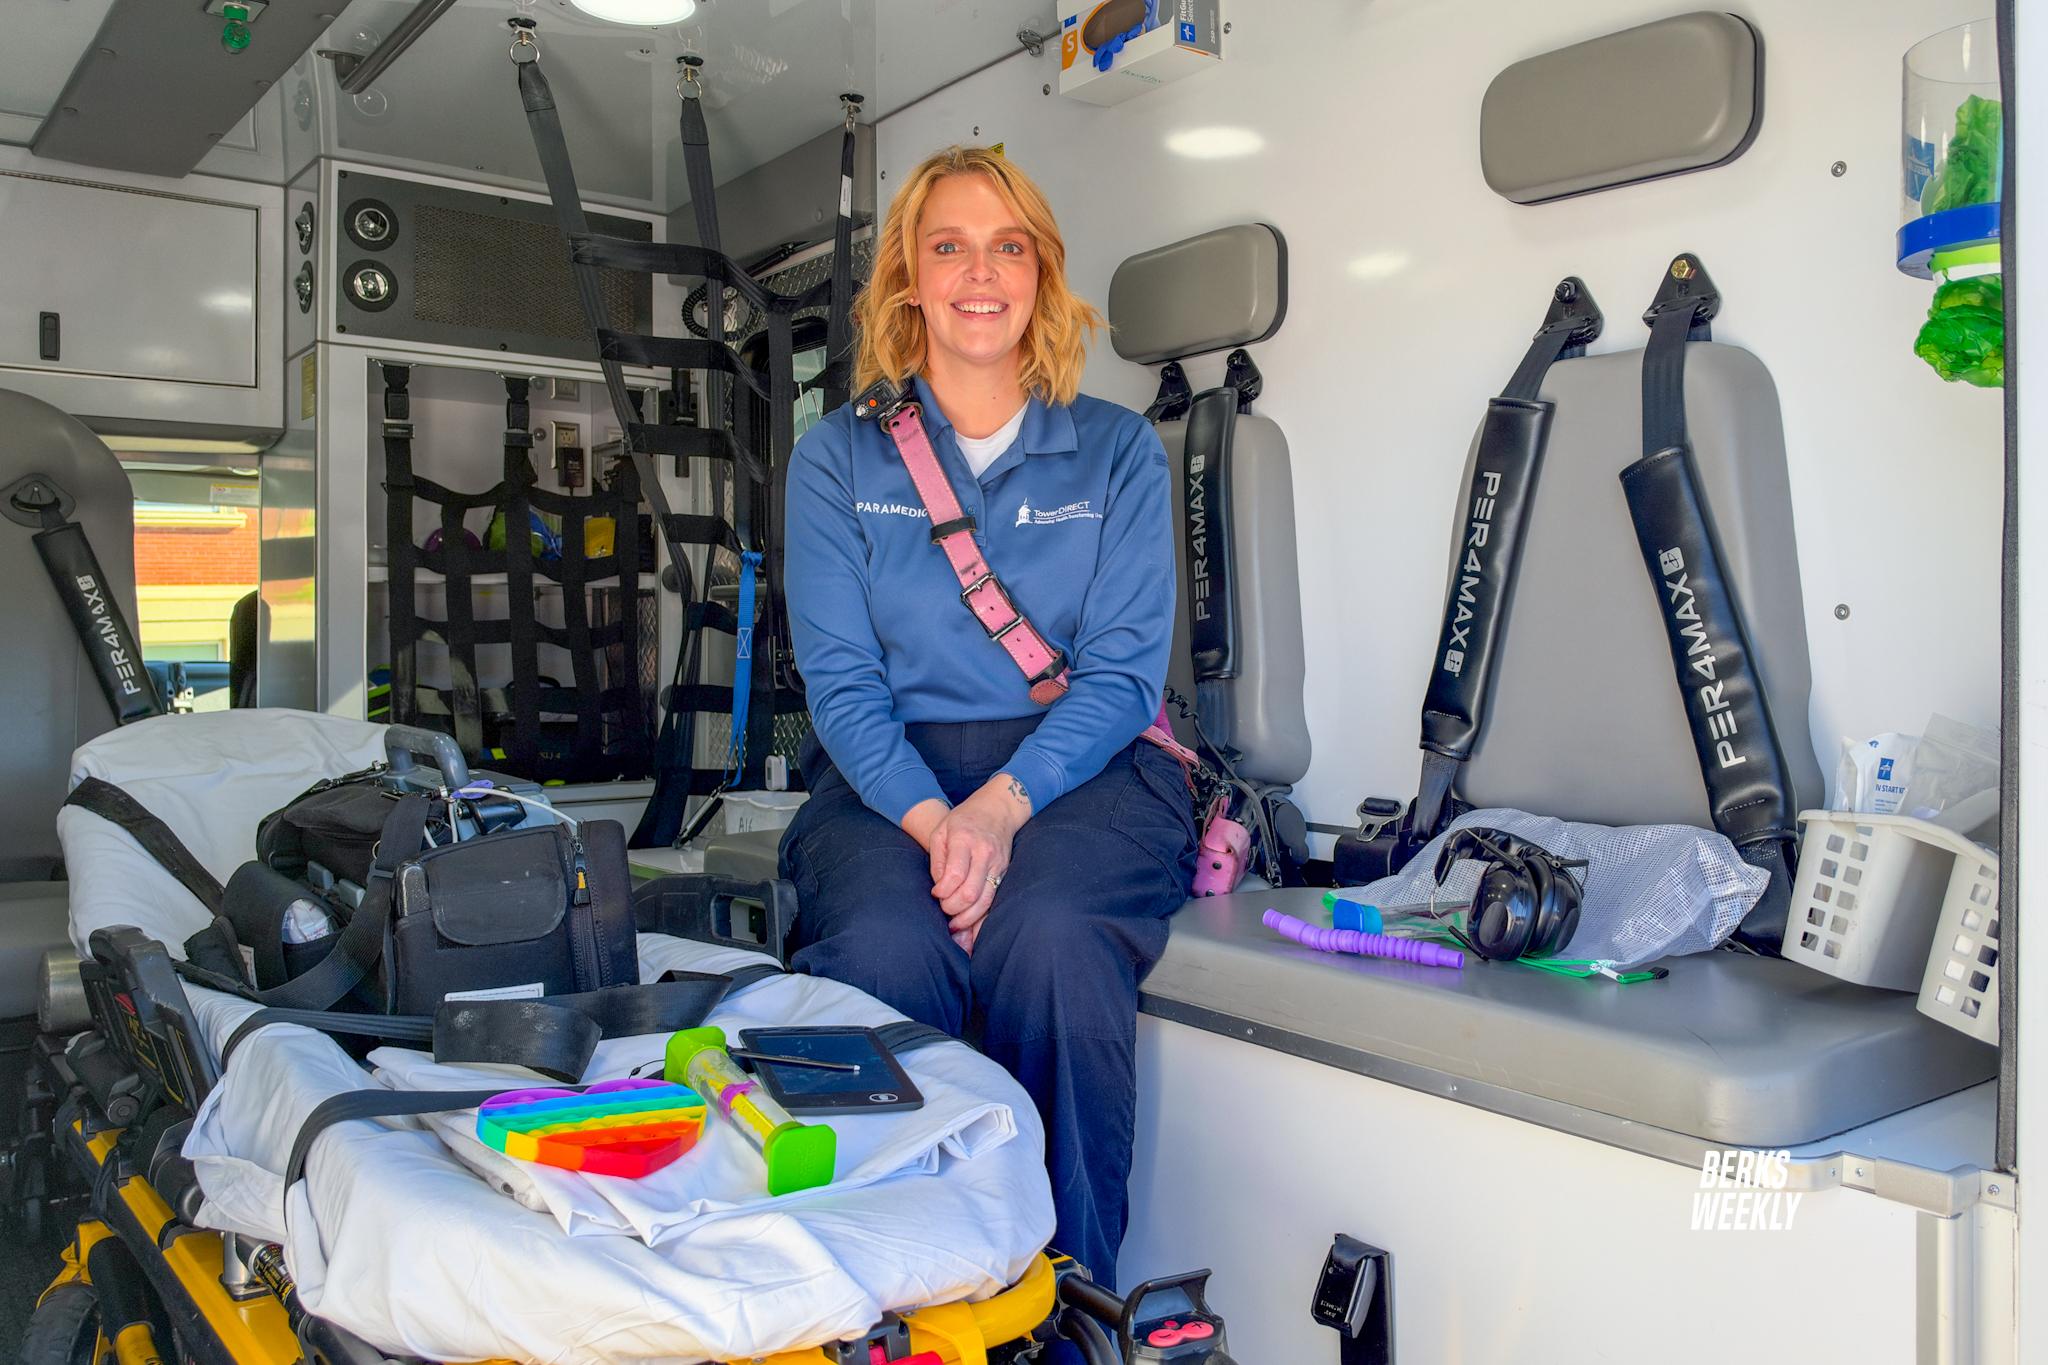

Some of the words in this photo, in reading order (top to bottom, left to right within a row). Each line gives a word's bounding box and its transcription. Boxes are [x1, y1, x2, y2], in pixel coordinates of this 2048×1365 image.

[1066, 34, 1075, 53] S
[1033, 501, 1091, 517] TowerDIRECT
[1190, 474, 1211, 622] PER4MAX
[1449, 471, 1502, 649] PER4MAX
[83, 588, 141, 695] PER4MAX
[1665, 572, 1746, 769] PER4MAX
[1881, 785, 1899, 793] START
